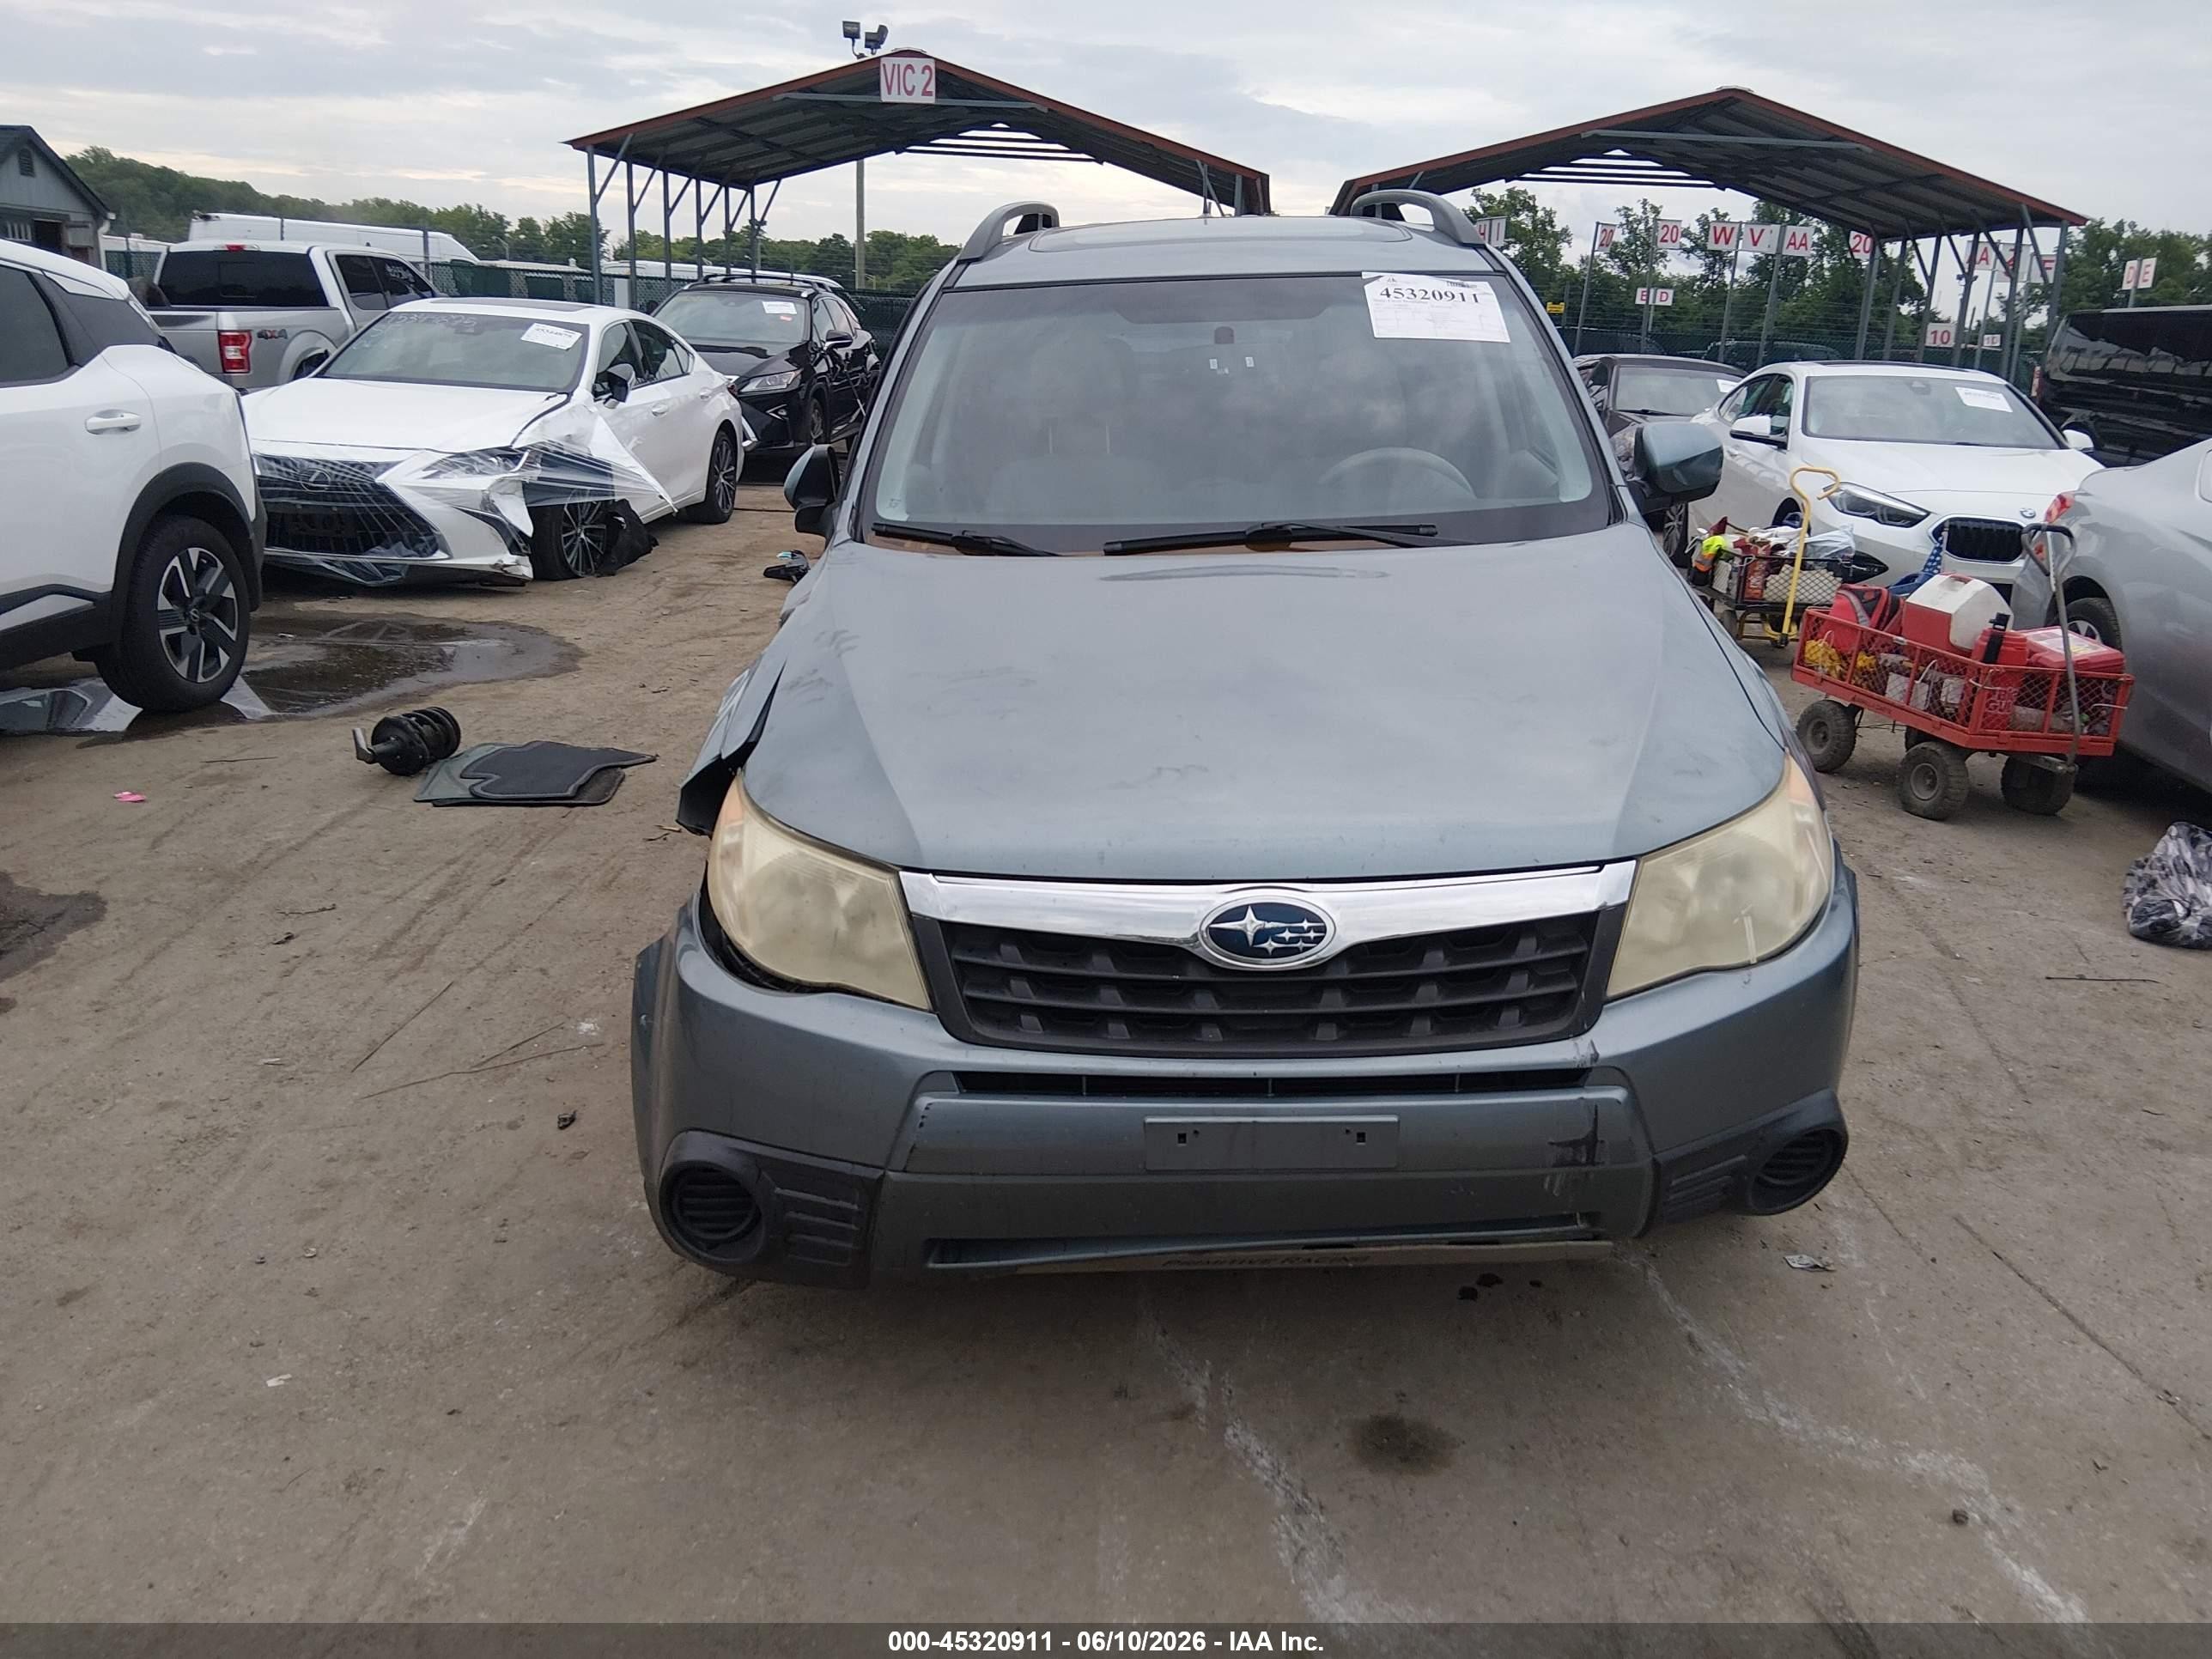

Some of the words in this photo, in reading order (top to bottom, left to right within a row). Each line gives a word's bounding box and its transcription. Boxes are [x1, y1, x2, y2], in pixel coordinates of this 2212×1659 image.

[883, 63, 916, 96] VIC
[921, 64, 934, 97] 2
[1600, 228, 1615, 248] 20
[1659, 224, 1680, 244] 20
[1713, 226, 1735, 246] W
[1749, 228, 1765, 247] V
[1786, 231, 1808, 251] AA
[1850, 234, 1873, 254] 20
[1380, 286, 1480, 304] 45320911
[1659, 290, 1669, 302] D
[1930, 329, 1951, 345] 10
